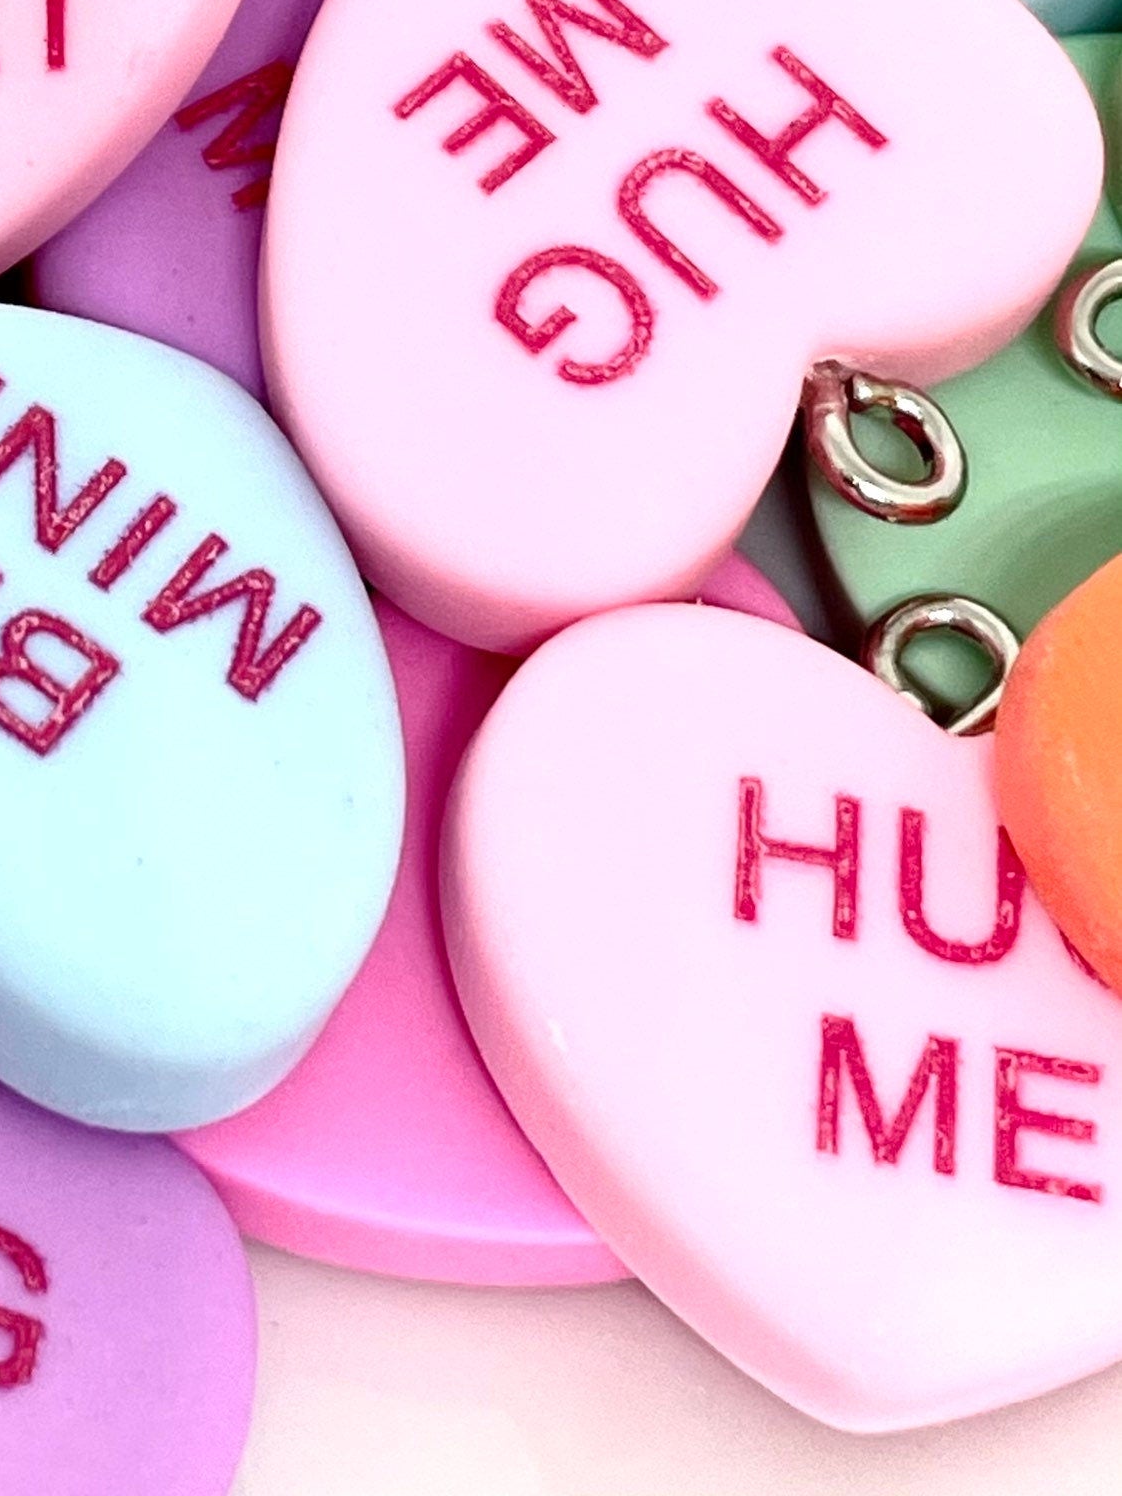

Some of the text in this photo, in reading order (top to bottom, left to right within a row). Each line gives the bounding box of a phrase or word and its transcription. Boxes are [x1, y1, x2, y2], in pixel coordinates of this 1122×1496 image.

[494, 45, 890, 387] HUG
[734, 775, 1114, 991] HU
[816, 1012, 1104, 1205] ME
